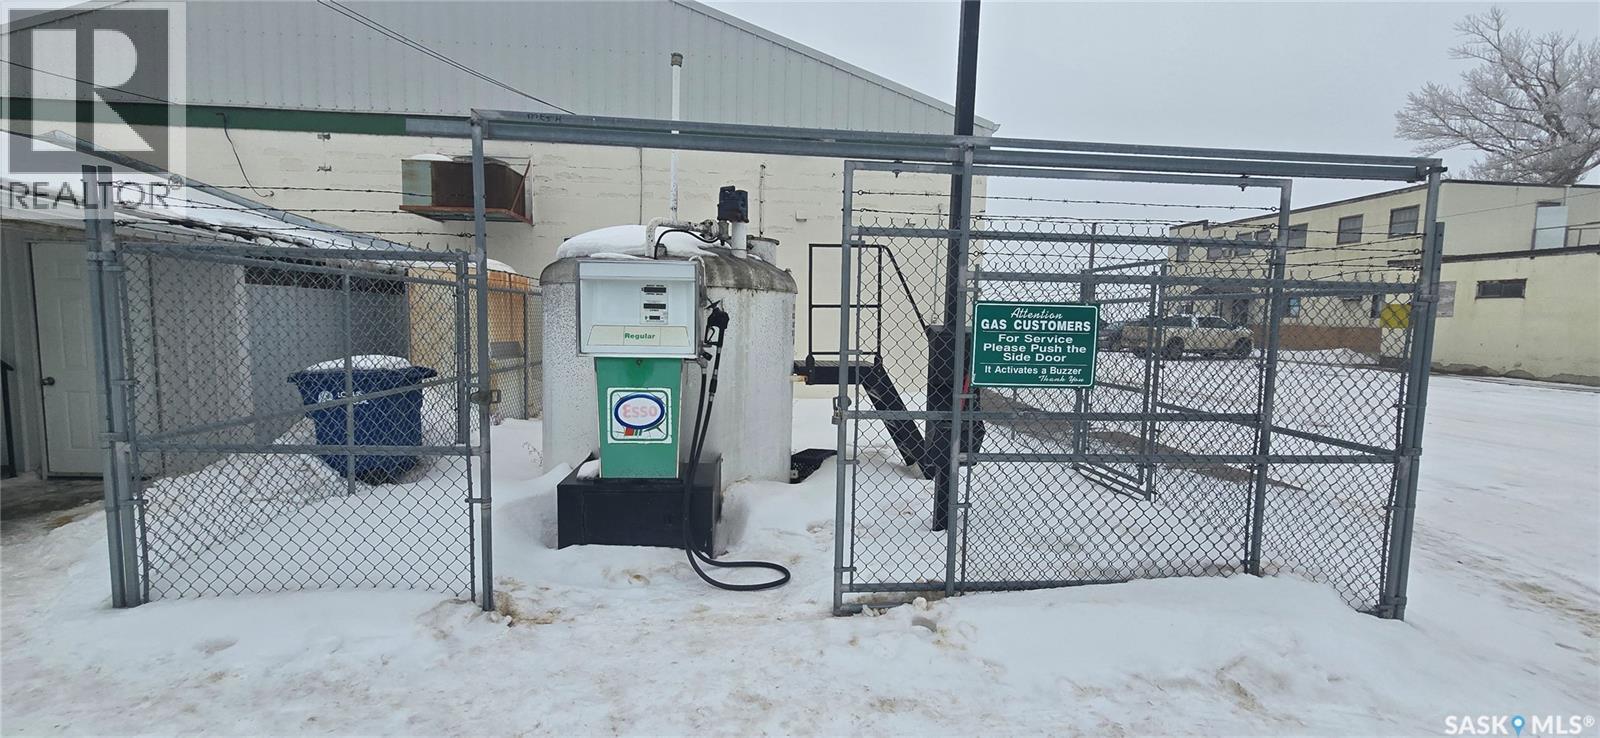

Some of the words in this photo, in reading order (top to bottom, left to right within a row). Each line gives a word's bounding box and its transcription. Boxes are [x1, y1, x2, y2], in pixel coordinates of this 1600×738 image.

[1010, 307, 1063, 319] Attention
[981, 319, 1007, 330] GAS
[1014, 320, 1091, 332] CUSTOMERS
[624, 333, 656, 341] Regular
[998, 334, 1020, 343] For
[1024, 334, 1073, 344] Service
[983, 343, 1026, 353] Please
[1031, 344, 1062, 353] Push
[1067, 345, 1087, 354] the
[1003, 353, 1031, 362] Side
[1035, 354, 1067, 362] Door
[994, 366, 1038, 374] Activates
[1050, 367, 1082, 375] Buzzer
[1068, 376, 1084, 384] You
